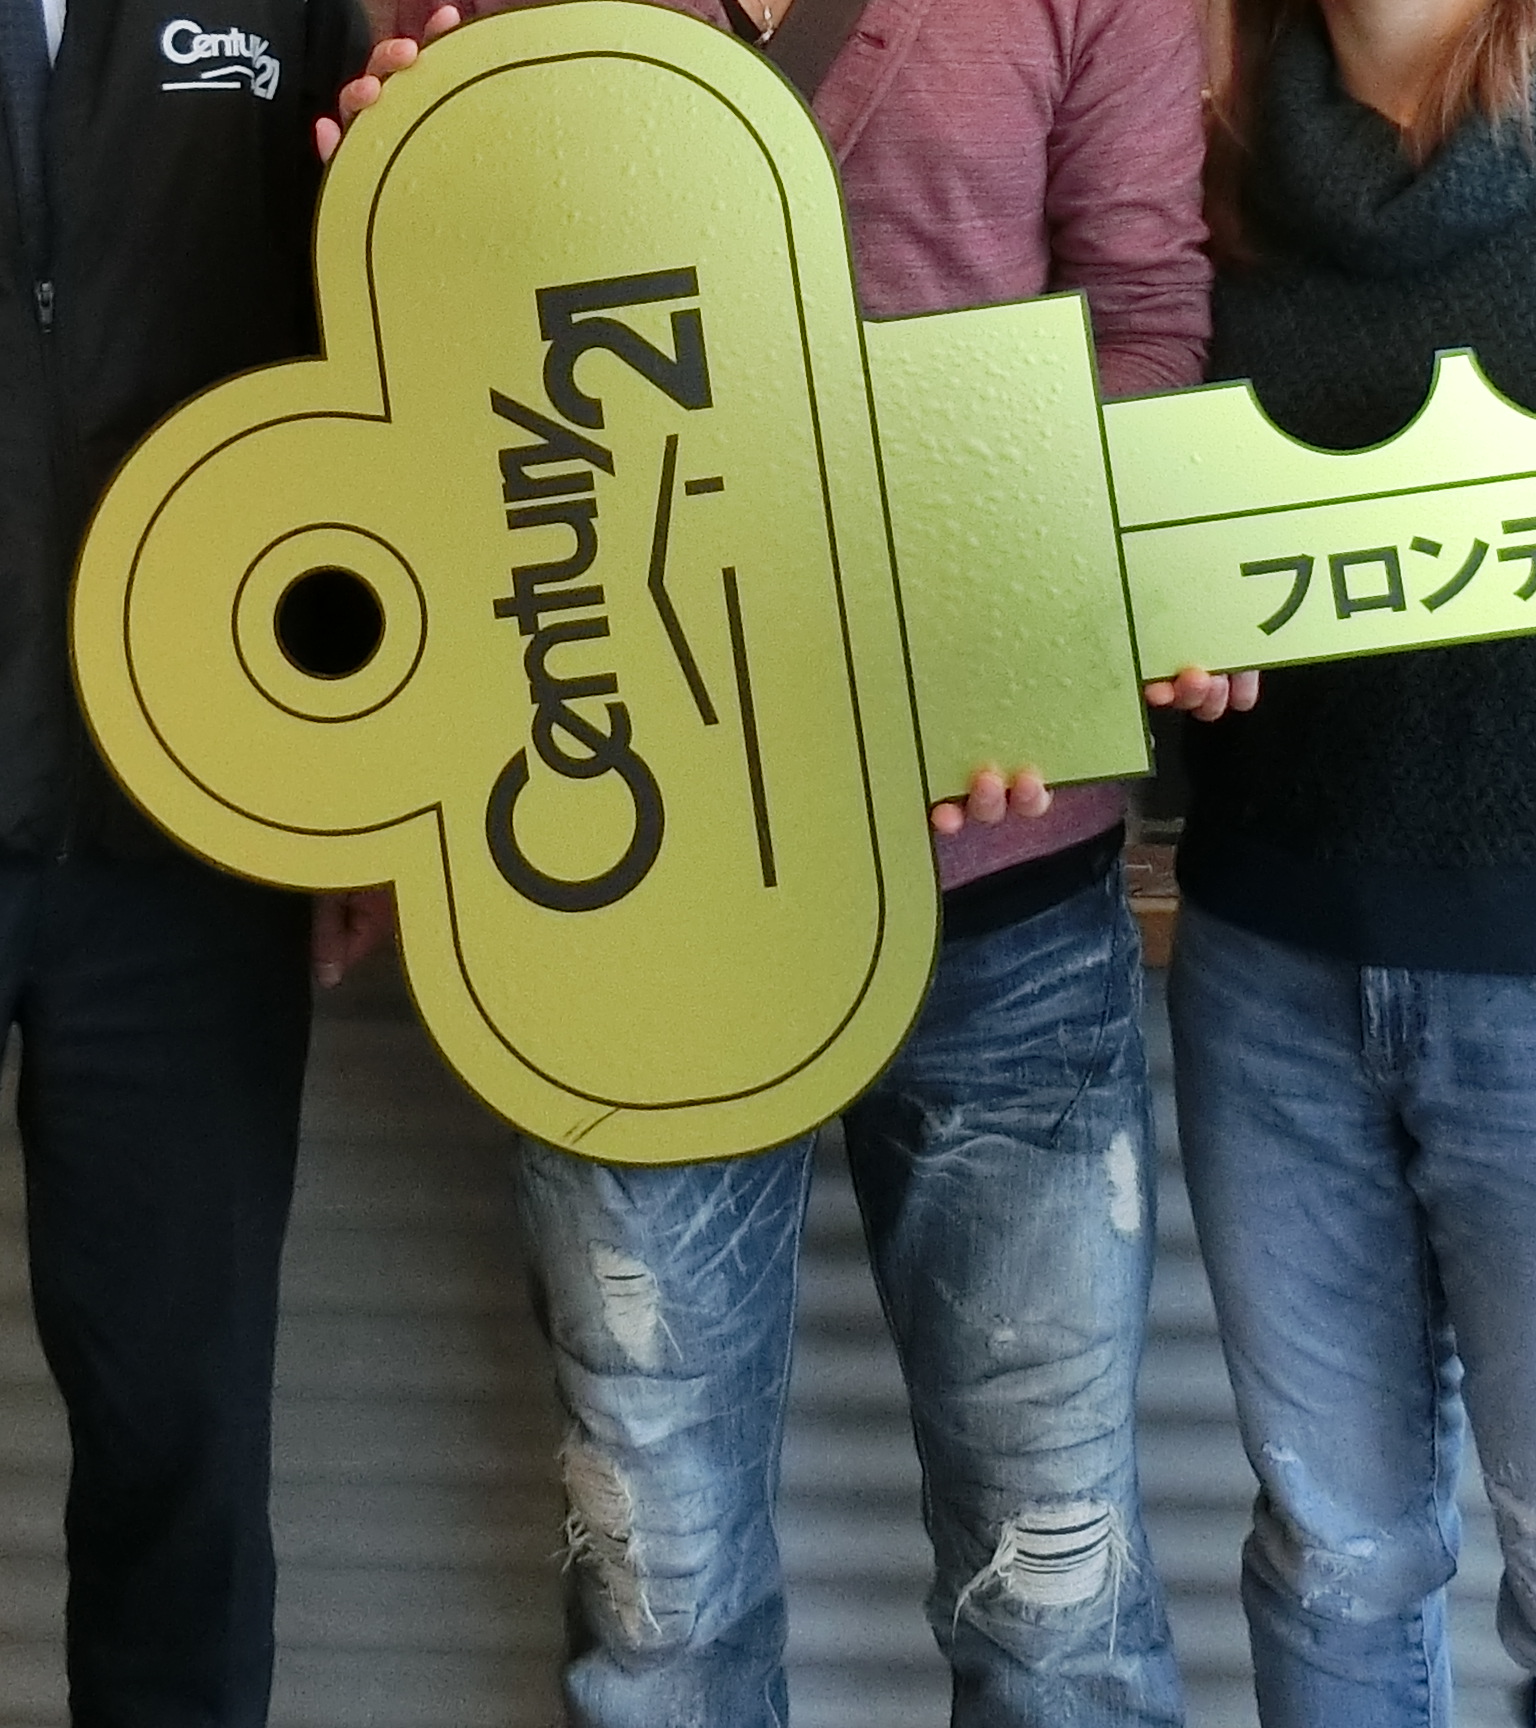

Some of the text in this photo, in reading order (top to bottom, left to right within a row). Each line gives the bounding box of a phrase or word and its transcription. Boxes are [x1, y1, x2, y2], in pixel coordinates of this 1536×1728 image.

[253, 54, 281, 101] 21
[485, 265, 714, 913] Century 21
